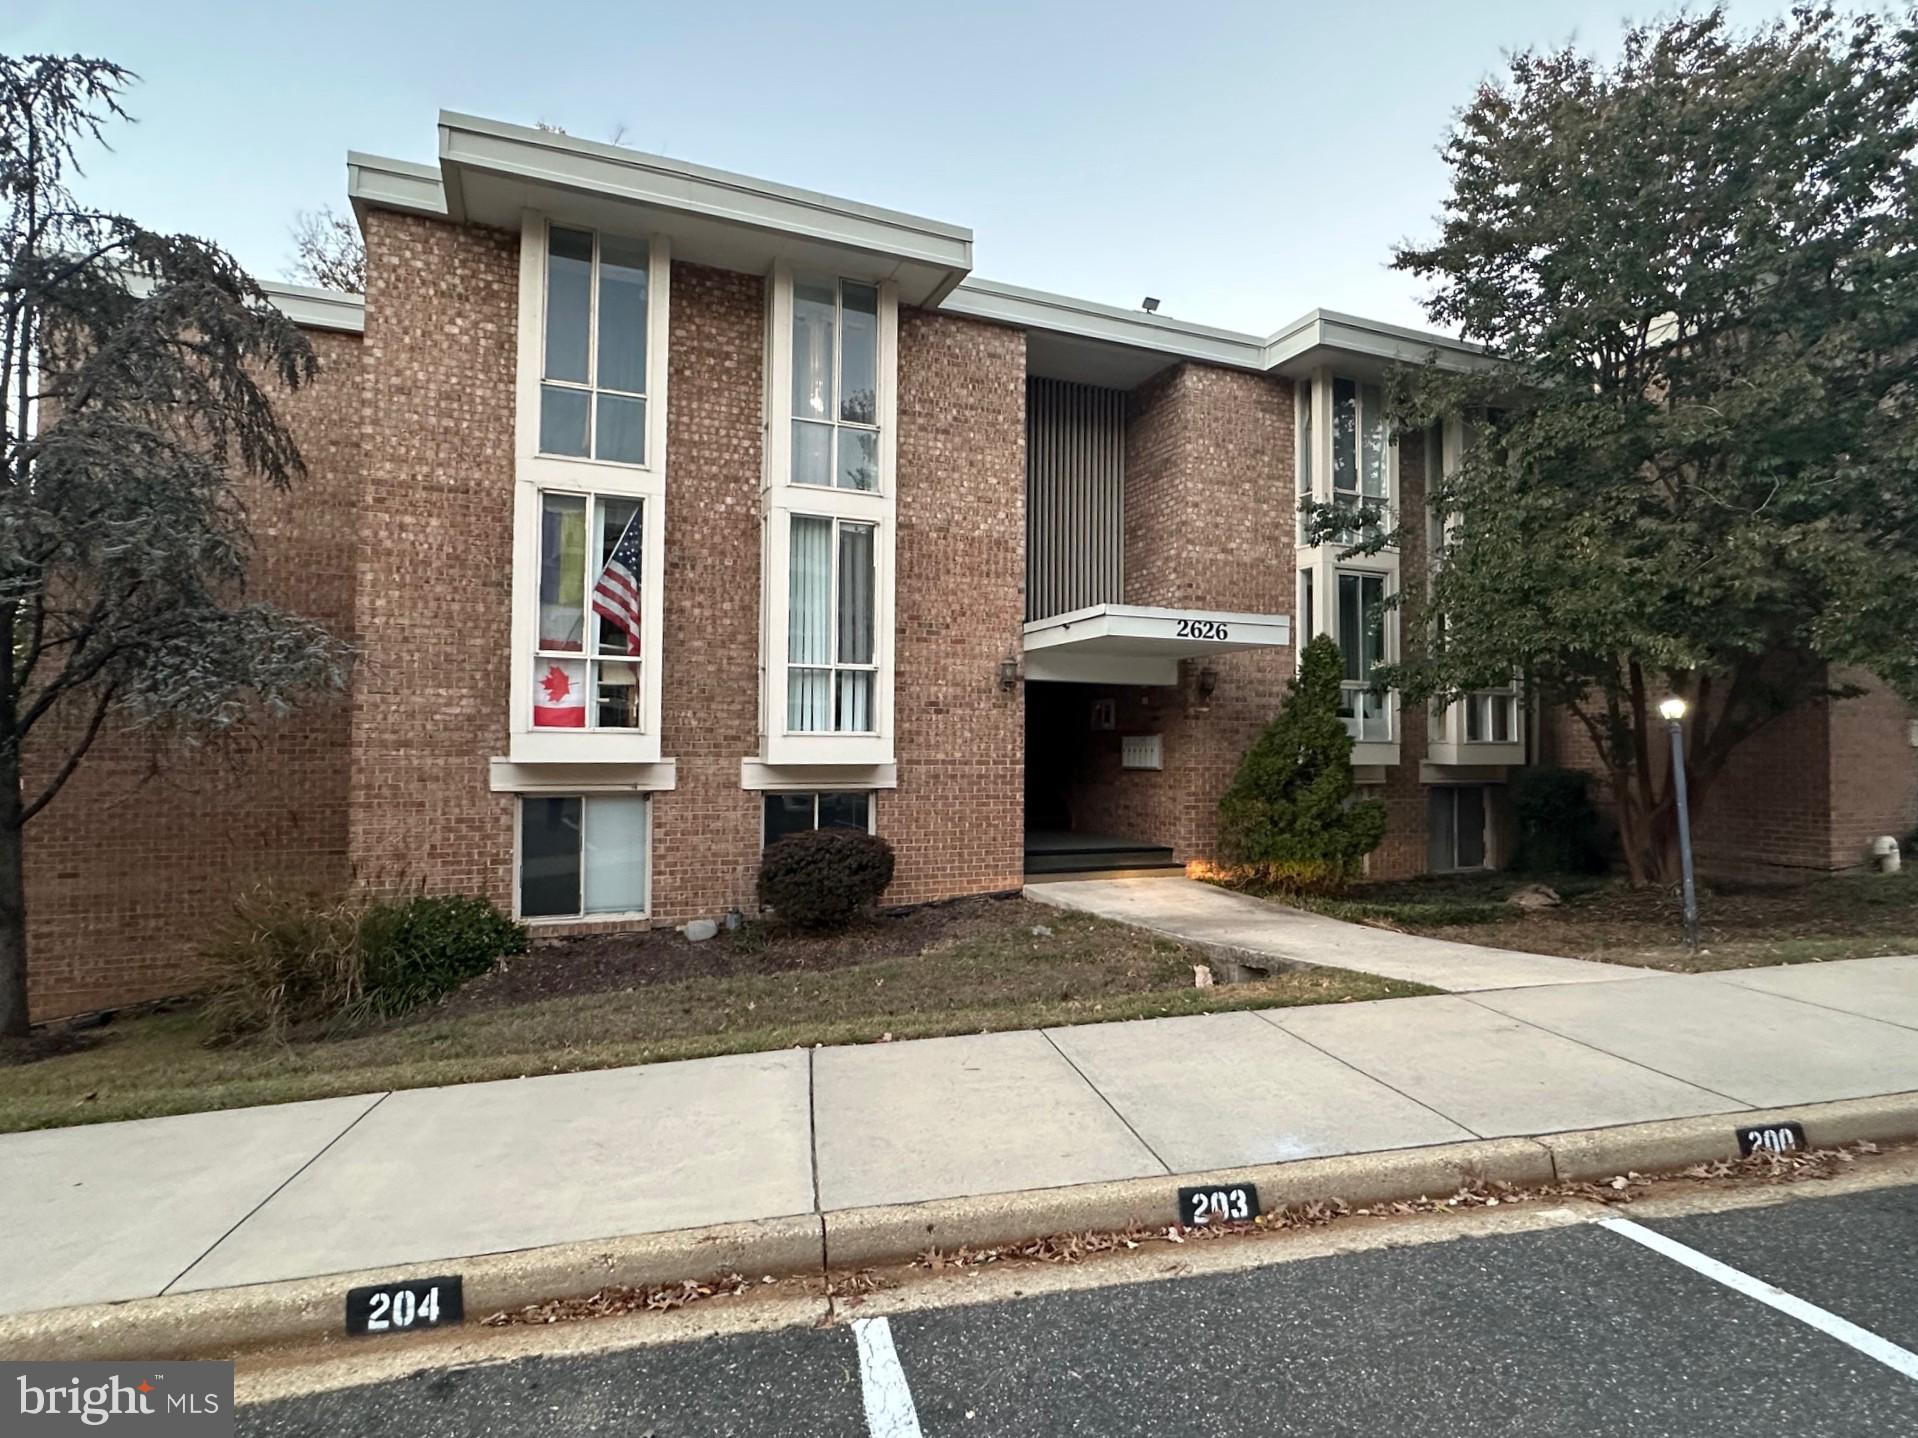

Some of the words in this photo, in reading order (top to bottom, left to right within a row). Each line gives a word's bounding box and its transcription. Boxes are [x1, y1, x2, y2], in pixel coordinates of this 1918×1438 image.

[1177, 620, 1228, 640] 2626
[1192, 1189, 1248, 1224] 203
[368, 1287, 440, 1330] 204
